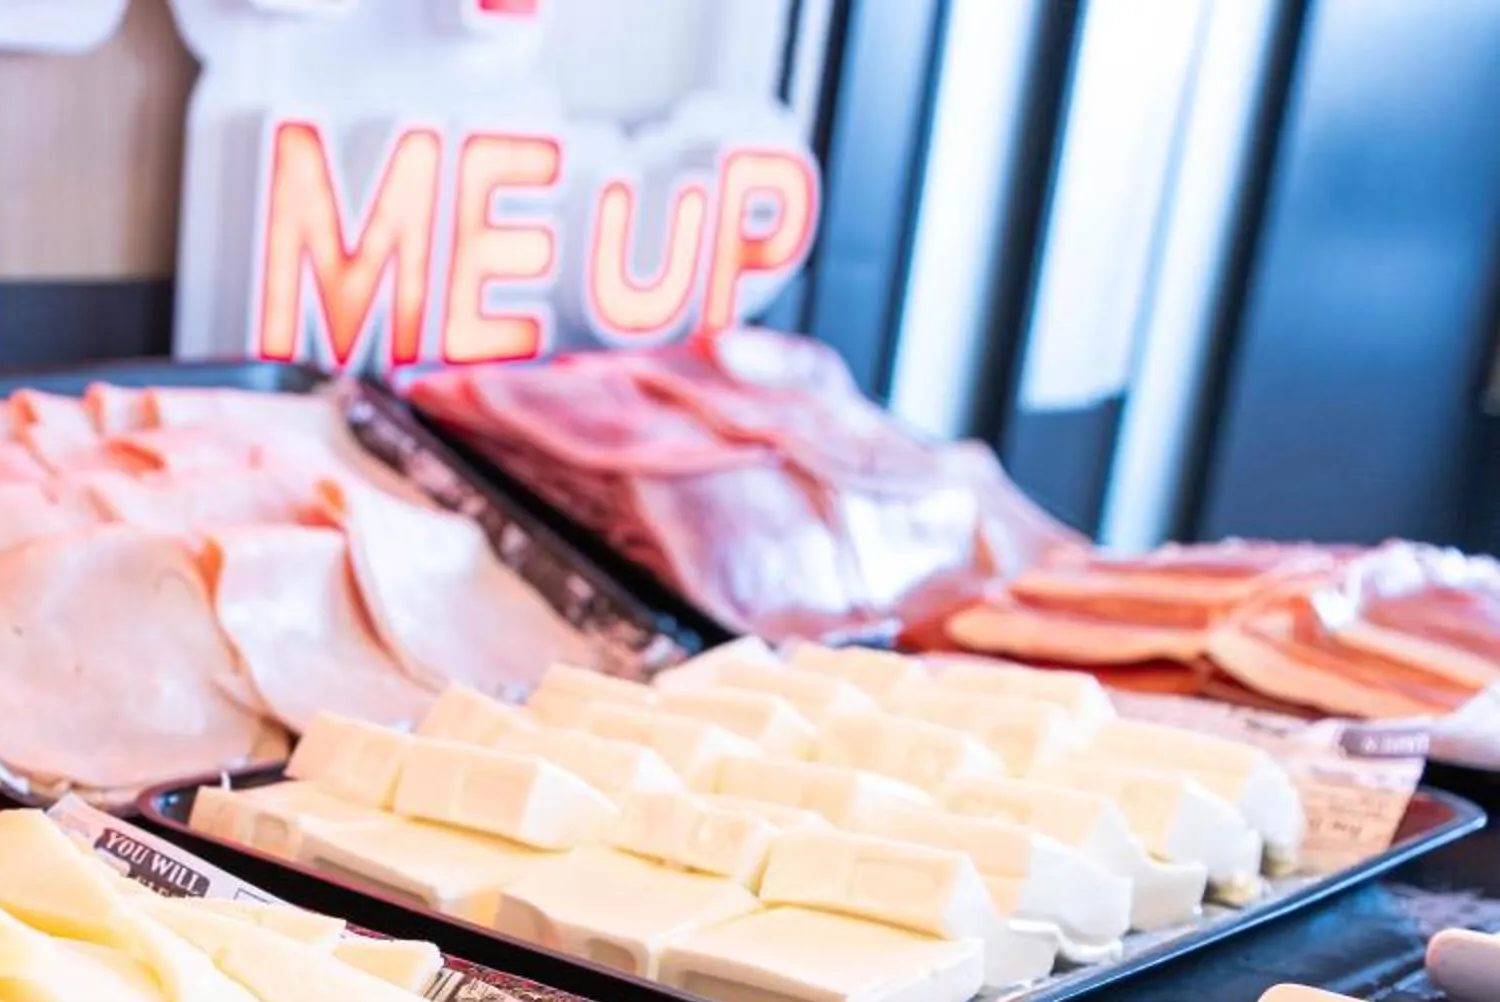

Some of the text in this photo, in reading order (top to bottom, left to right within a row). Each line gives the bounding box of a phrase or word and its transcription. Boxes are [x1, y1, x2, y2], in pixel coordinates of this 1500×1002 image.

[256, 121, 819, 367] ME UP
[106, 831, 151, 864] YOU
[151, 853, 201, 893] WILL
